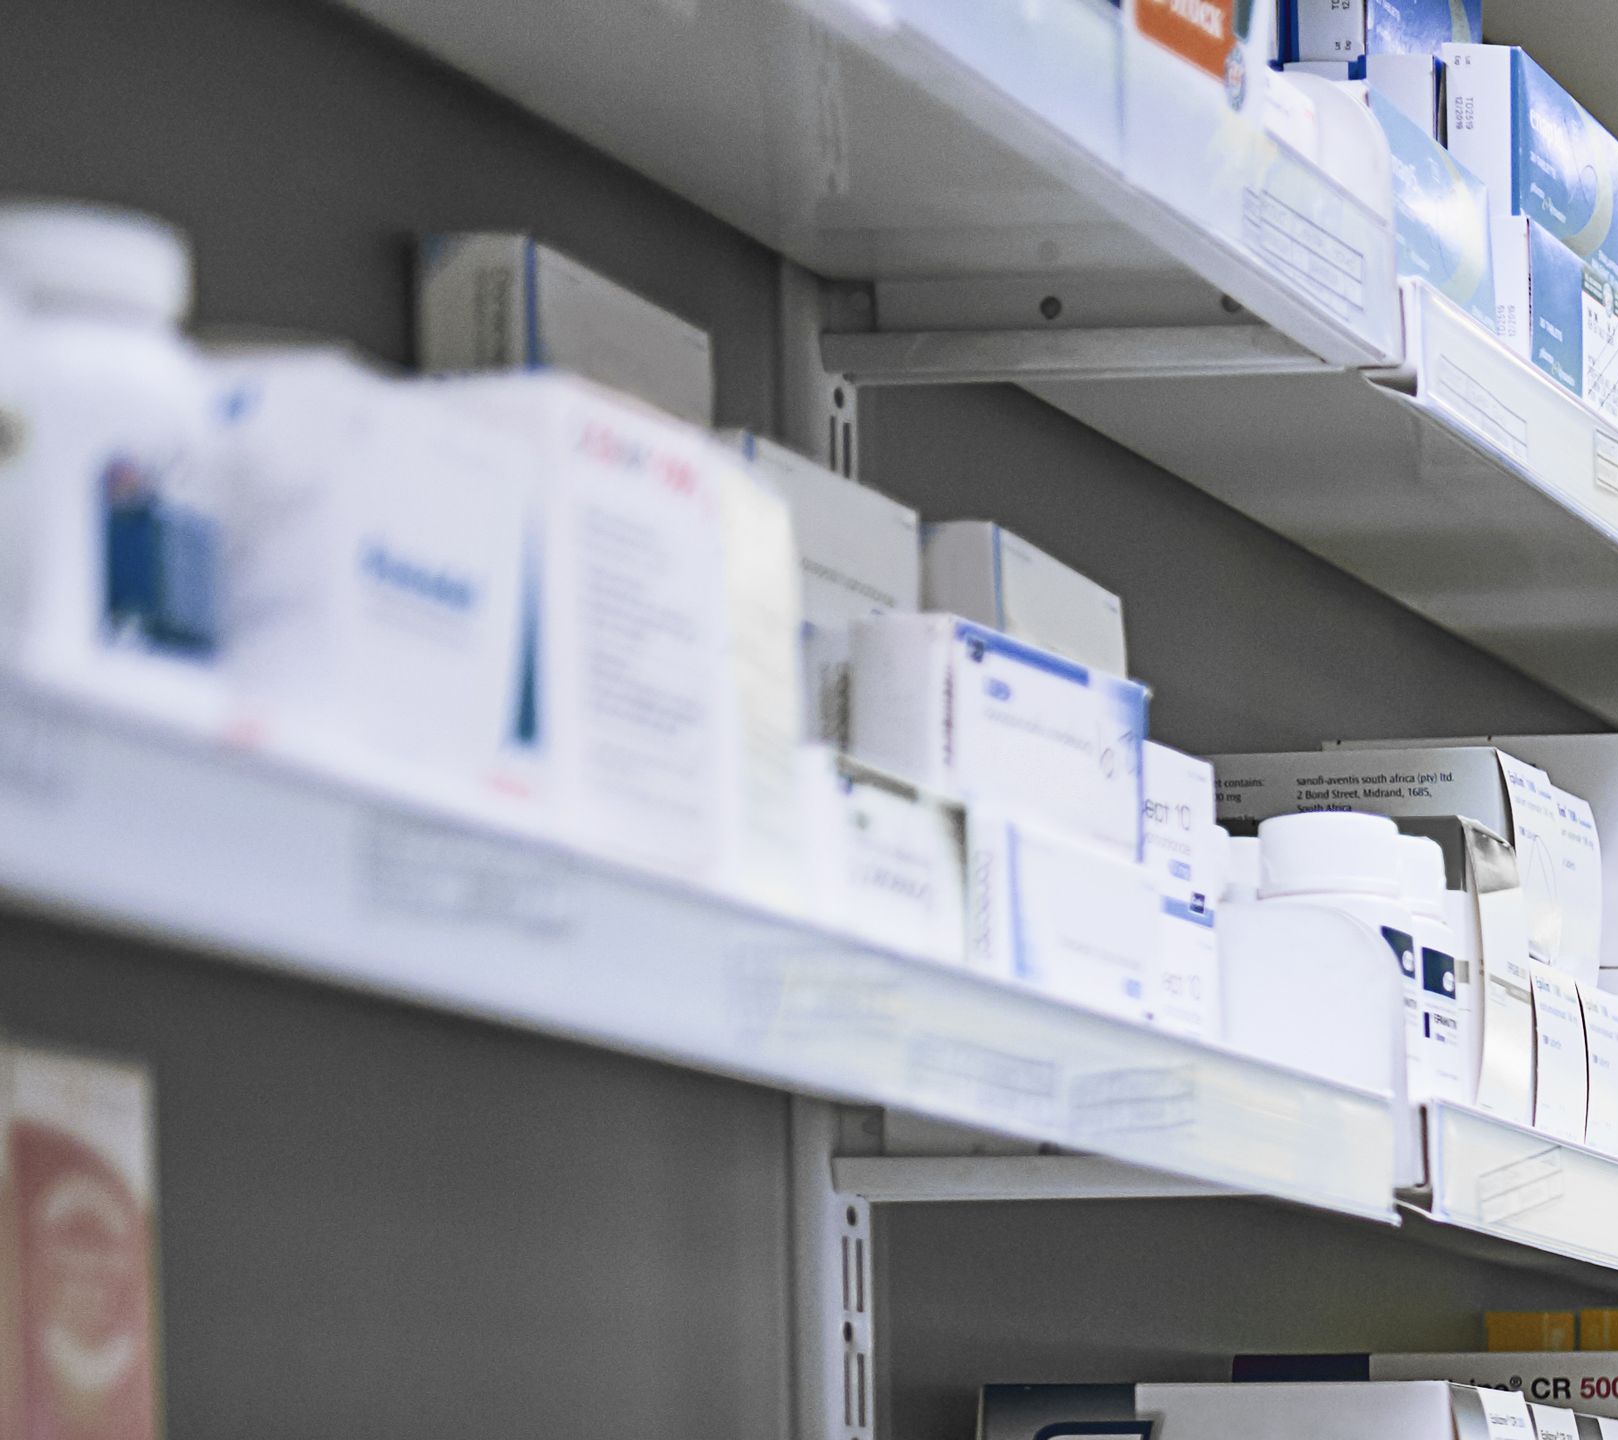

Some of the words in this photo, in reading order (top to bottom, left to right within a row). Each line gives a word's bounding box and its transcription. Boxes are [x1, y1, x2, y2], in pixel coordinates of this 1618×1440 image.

[1361, 775, 1388, 785] south
[1390, 773, 1415, 784] africa
[1417, 772, 1438, 784] (pty)
[1297, 790, 1303, 800] 2
[1305, 789, 1330, 800] Bond
[1332, 789, 1361, 800] Street,
[1363, 788, 1405, 799] Midrand,
[1408, 786, 1432, 798] 1685,
[1297, 803, 1321, 812] South
[1323, 803, 1352, 812] Africa
[1530, 1377, 1572, 1400] CR
